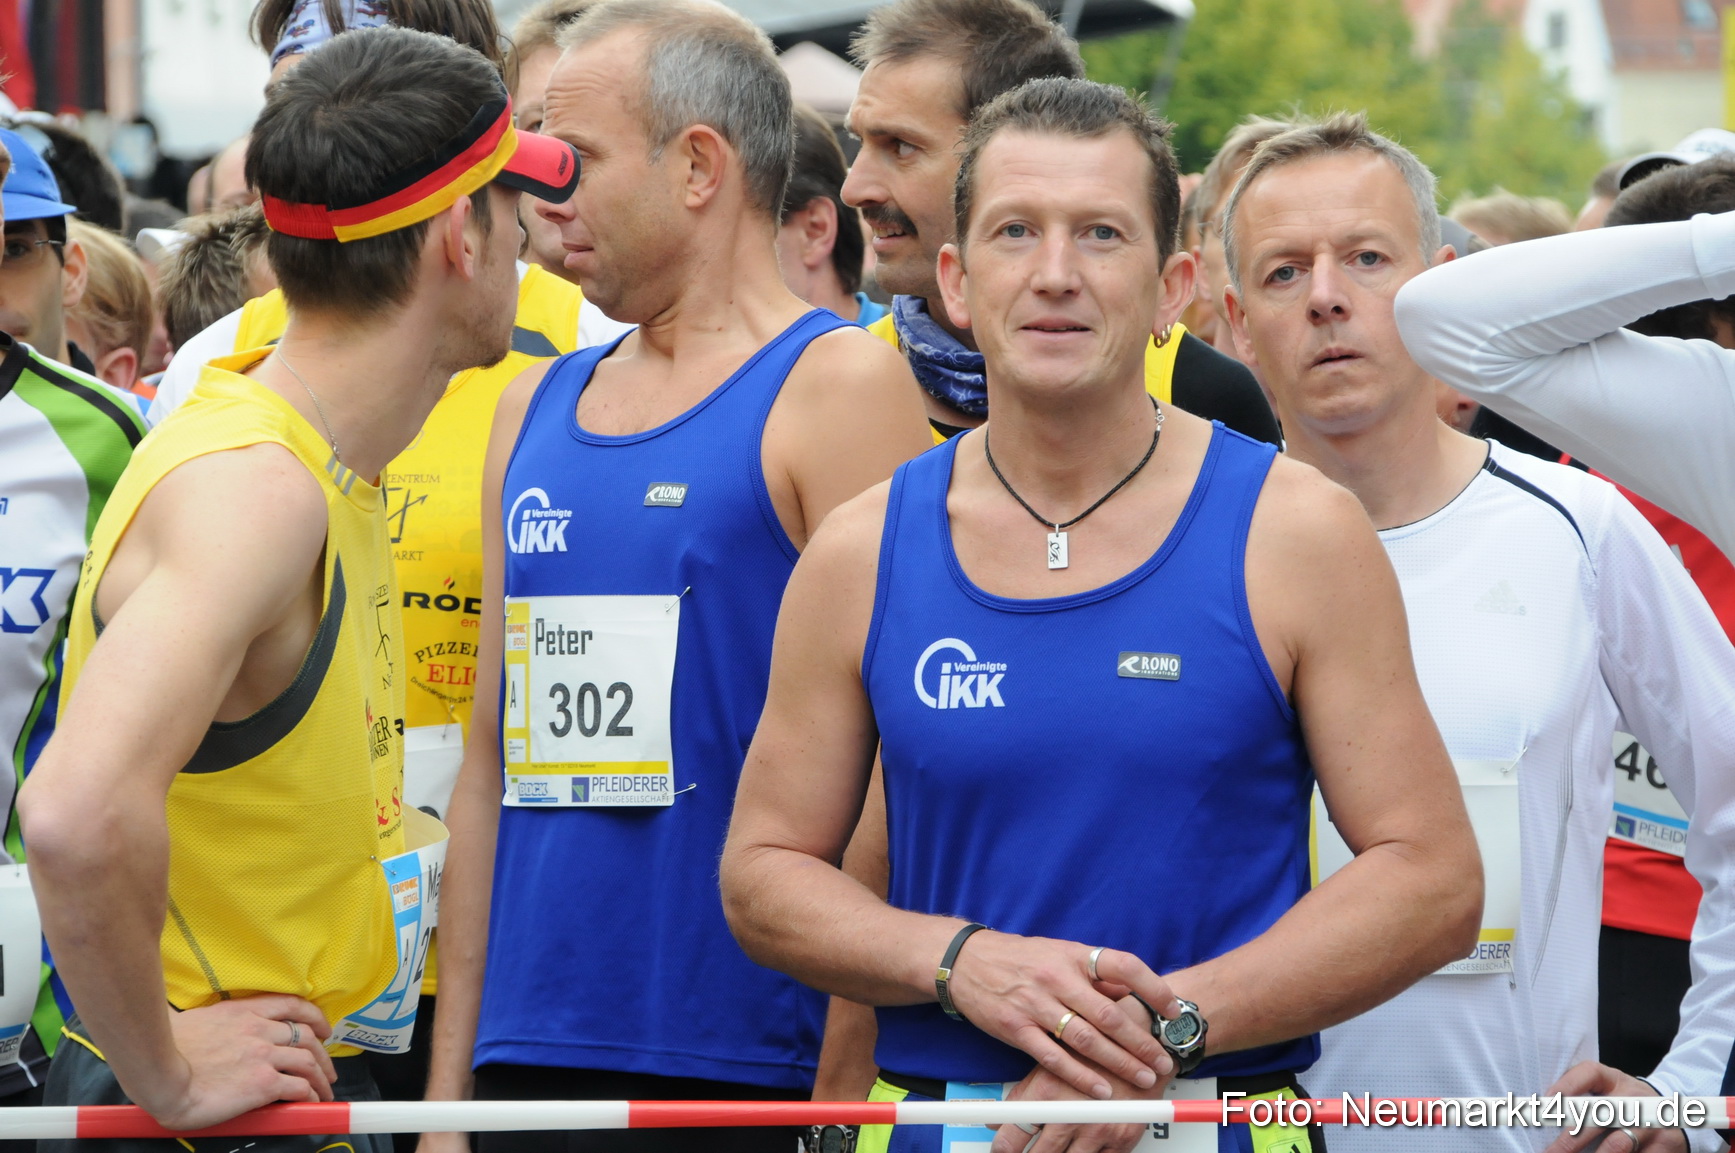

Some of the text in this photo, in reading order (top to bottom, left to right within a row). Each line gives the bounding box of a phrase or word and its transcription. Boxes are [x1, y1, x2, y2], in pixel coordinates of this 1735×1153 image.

[658, 486, 686, 500] RONO
[532, 508, 573, 519] Vereinigte
[461, 618, 480, 628] en
[536, 618, 594, 656] Peter
[954, 661, 1008, 673] Vereinigte
[1142, 656, 1179, 672] RONO
[427, 663, 477, 686] ELI
[510, 680, 517, 708] A
[549, 681, 633, 738] 302
[592, 776, 669, 793] PFLEIDERER
[591, 795, 670, 804] AKTIENGESELLSCHAFT
